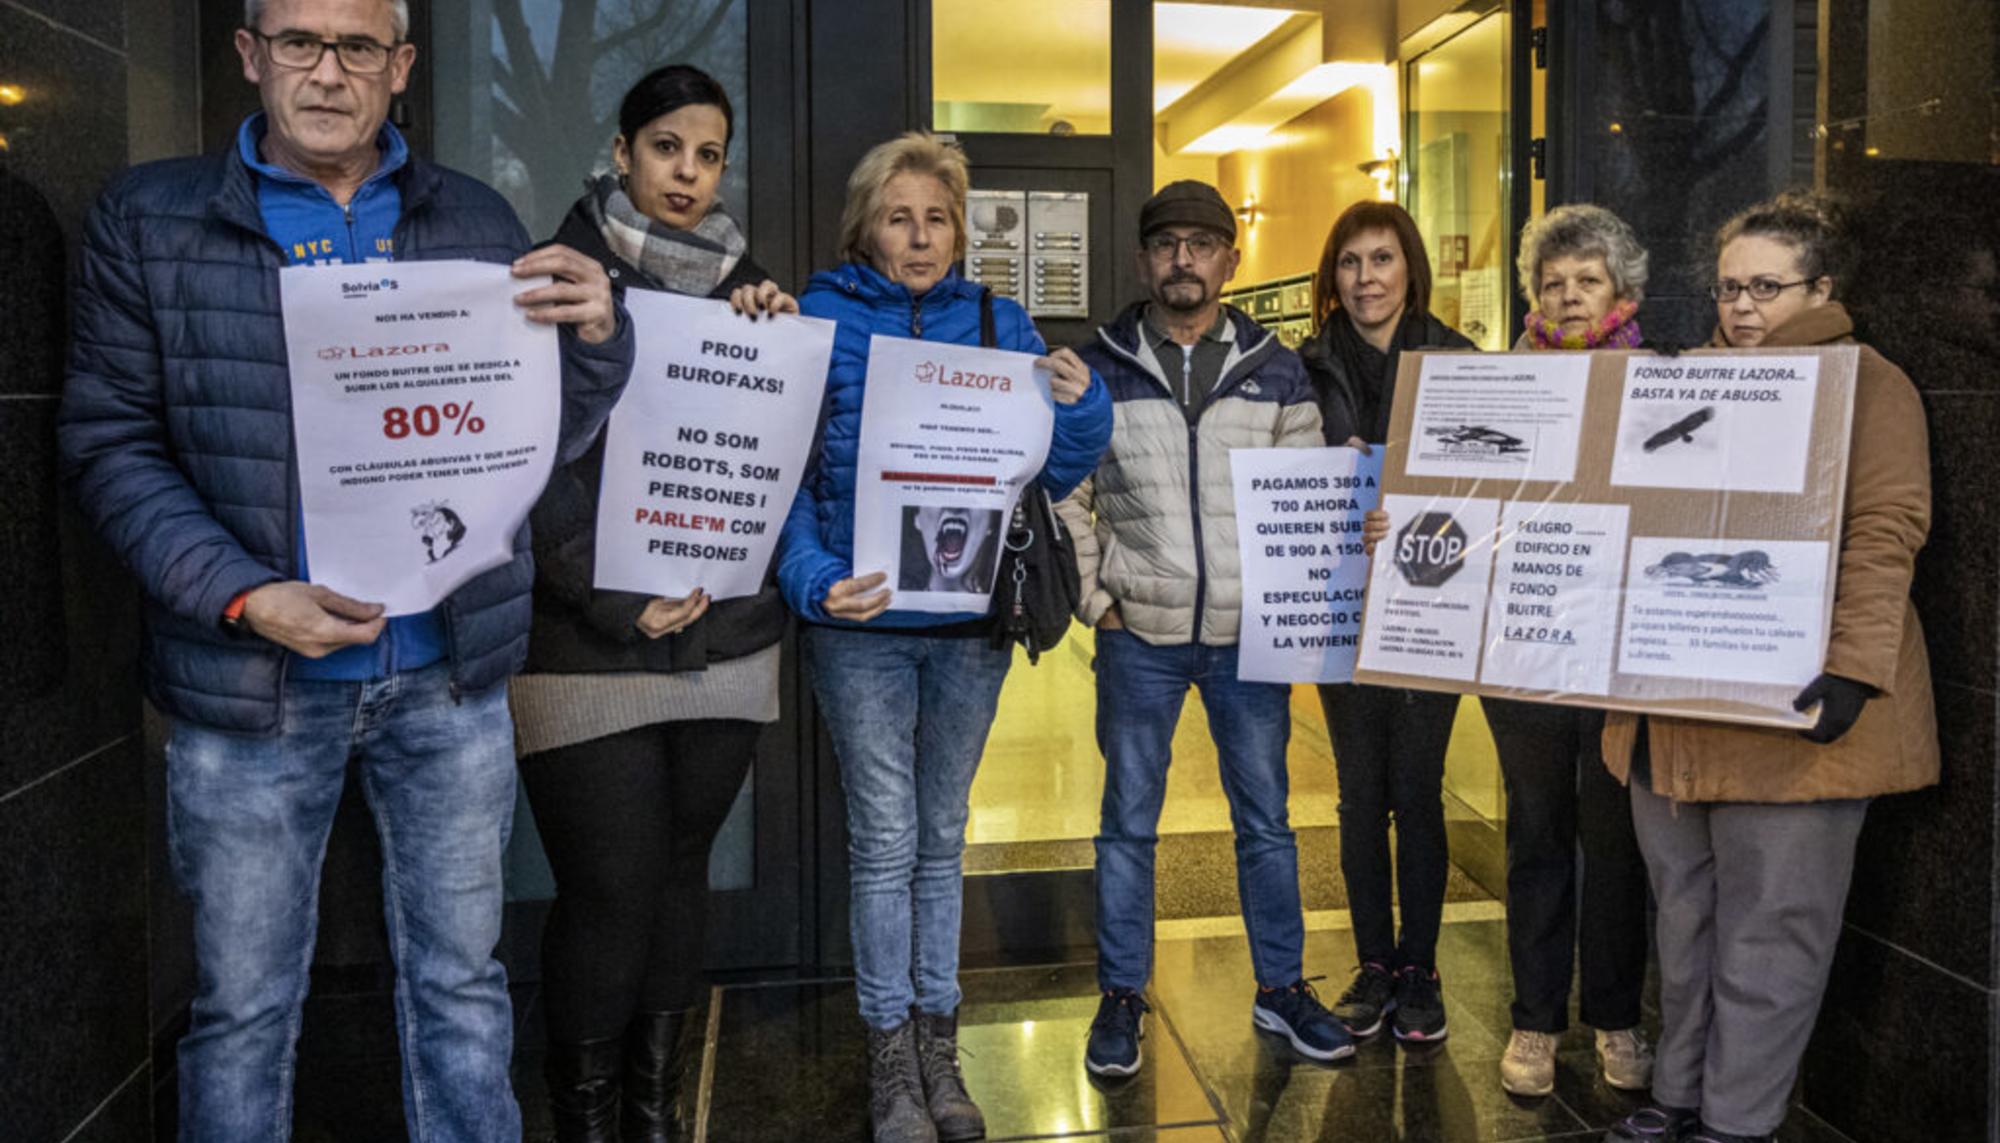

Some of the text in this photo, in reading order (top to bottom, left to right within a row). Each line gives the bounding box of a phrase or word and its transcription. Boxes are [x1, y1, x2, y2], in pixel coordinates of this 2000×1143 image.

[293, 239, 333, 258] NYC
[342, 282, 380, 293] Solvia
[375, 313, 397, 323] NOS
[400, 312, 415, 321] HA
[351, 343, 449, 358] Lazora
[701, 340, 759, 362] PROU
[334, 372, 350, 381] UN
[353, 369, 389, 379] FONDO
[392, 366, 430, 376] BUITRE
[433, 364, 454, 373] QUE
[458, 363, 470, 371] SE
[474, 361, 511, 370] DEDICA
[938, 364, 1012, 392] Lazora
[1634, 367, 1683, 379] FONDO
[1686, 367, 1736, 380] BUITRE
[344, 383, 378, 393] SUBIR
[380, 381, 400, 390] LOS
[403, 376, 467, 388] ALQUILERES
[494, 373, 513, 381] DEL
[667, 363, 784, 395] BUROFAXS!
[1631, 388, 1783, 401] BASTA YA DE ABUSOS.
[382, 400, 486, 440] 80%
[677, 426, 759, 451] NO SOM
[329, 465, 352, 474] CON
[355, 458, 417, 472] CLÁUSULAS
[420, 454, 472, 466] ABUSIVAS
[474, 453, 481, 461] Y
[484, 451, 503, 460] QUE
[642, 451, 780, 482] ROBOTS, SOM
[340, 458, 529, 486] INDIGNO PODER TENER UNA VIVIENDA
[1252, 475, 1376, 491] PAGAMOS 380 A
[648, 481, 767, 508] PERSONES I
[1272, 498, 1360, 512] 700 AHORA
[635, 508, 767, 535] PARLE'M COM
[1256, 521, 1365, 535] QUIEREN SUB
[1518, 521, 1573, 534] PELIGRO
[648, 539, 749, 561] PERSONES
[1265, 543, 1364, 557] DE 900 A 150
[1400, 534, 1463, 566] STOP
[1515, 542, 1591, 556] EDIFICIO EN
[1308, 568, 1331, 580] NO
[1512, 562, 1583, 576] MANOS DE
[1510, 582, 1557, 596] FONDO
[1507, 603, 1553, 617] BUITRE
[1646, 607, 1682, 616] estamos
[1261, 614, 1271, 627] Y
[1276, 611, 1348, 626] NEGOCIO
[1273, 636, 1294, 649] LA
[1703, 638, 1738, 650] familias
